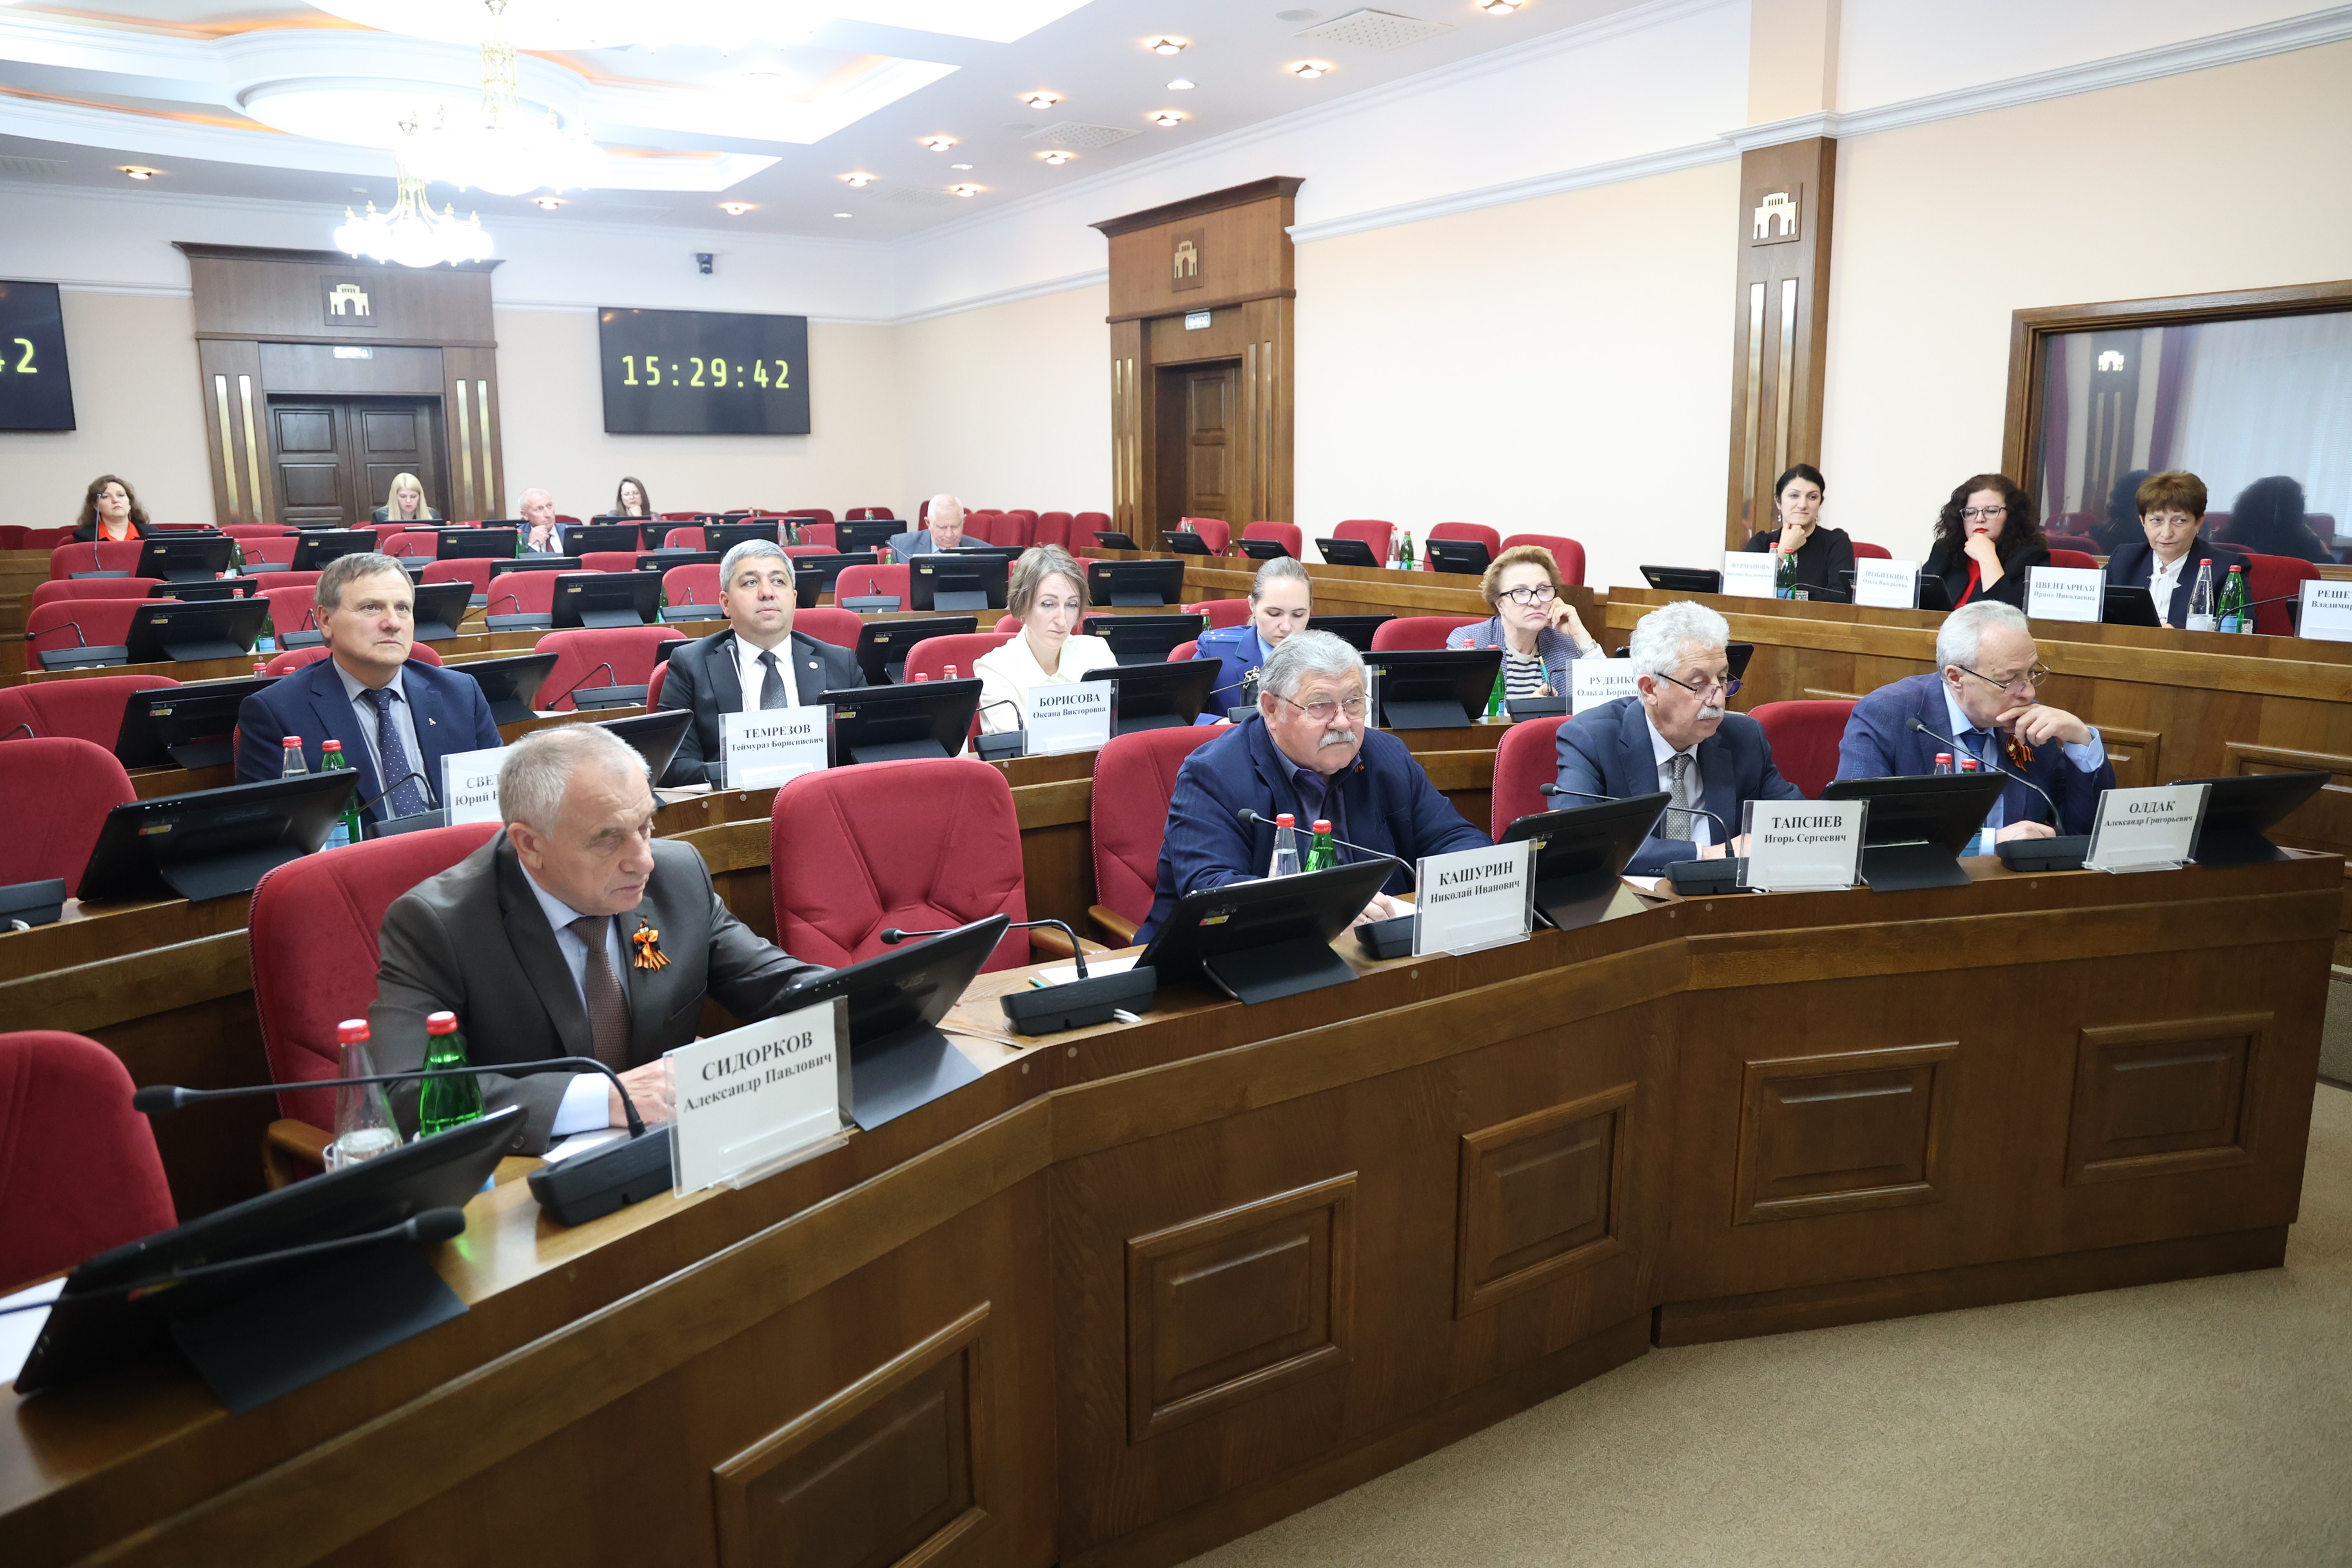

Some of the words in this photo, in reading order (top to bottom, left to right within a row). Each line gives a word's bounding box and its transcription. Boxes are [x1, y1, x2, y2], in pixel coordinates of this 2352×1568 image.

[622, 355, 789, 388] 15:29:42
[1863, 571, 1908, 580] ДРОБИТКИНА
[2035, 582, 2095, 592] ЦВЕНТАРНАЯ
[2056, 593, 2095, 601] Николаевна
[2318, 590, 2352, 598] РЕШЕ
[1039, 693, 1101, 707] БОРИСОВА
[1033, 710, 1061, 719] Оксана
[1063, 707, 1106, 716] Викторовна
[743, 724, 810, 739] ТЕМРЕЗОВ
[730, 743, 770, 751] Теймураз
[772, 738, 823, 748] Бориспиевич
[455, 792, 489, 807] Юрий
[2130, 801, 2176, 814] ОЛДАК
[1772, 816, 1842, 828] ТАПСИЕВ
[2146, 816, 2193, 825] Григорьевич
[1765, 834, 1794, 845] Игорь
[1797, 834, 1846, 845] Сергеевич
[1439, 861, 1513, 886] КАШУРИН
[1431, 887, 1472, 903] Николай
[1475, 880, 1520, 896] Иванович
[702, 1031, 813, 1081] СИДОРКОВ
[683, 1076, 761, 1113] Александр
[765, 1053, 832, 1084] Павлович
